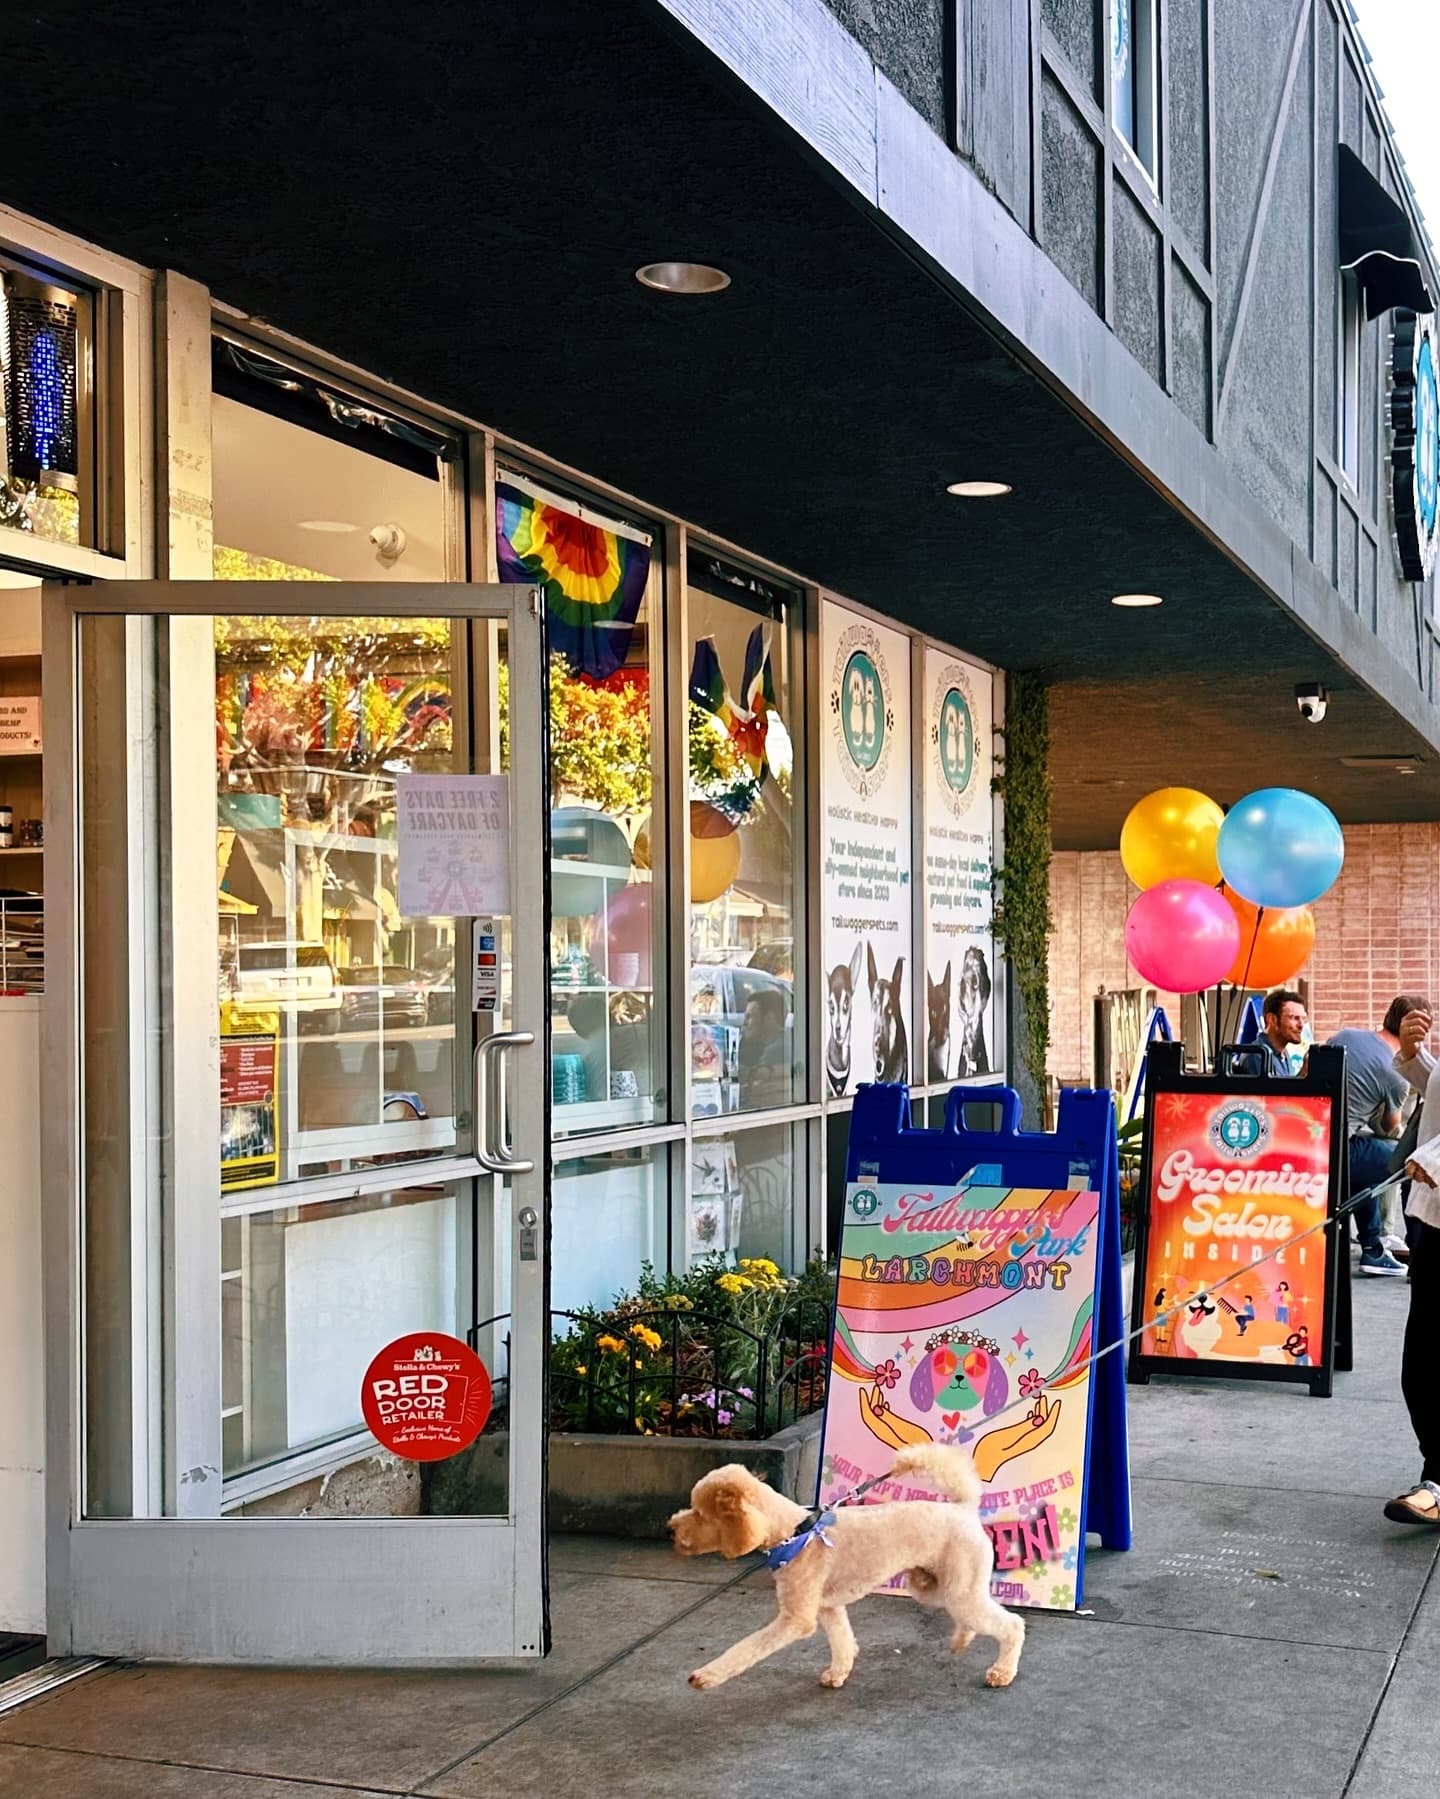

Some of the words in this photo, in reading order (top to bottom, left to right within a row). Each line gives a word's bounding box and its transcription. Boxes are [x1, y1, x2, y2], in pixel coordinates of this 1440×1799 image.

[1157, 1149, 1329, 1208] Grooming
[883, 1191, 1066, 1250] Tailwaggers
[1183, 1193, 1293, 1240] Salon
[1010, 1224, 1090, 1256] Park
[861, 1253, 1071, 1291] LARCHMONT
[372, 1375, 448, 1400] RED
[377, 1396, 446, 1415] DOOR
[382, 1411, 444, 1425] RETAILER
[832, 1454, 862, 1483] YOUR
[1013, 1478, 1057, 1504] PLACE
[1058, 1470, 1074, 1489] IS
